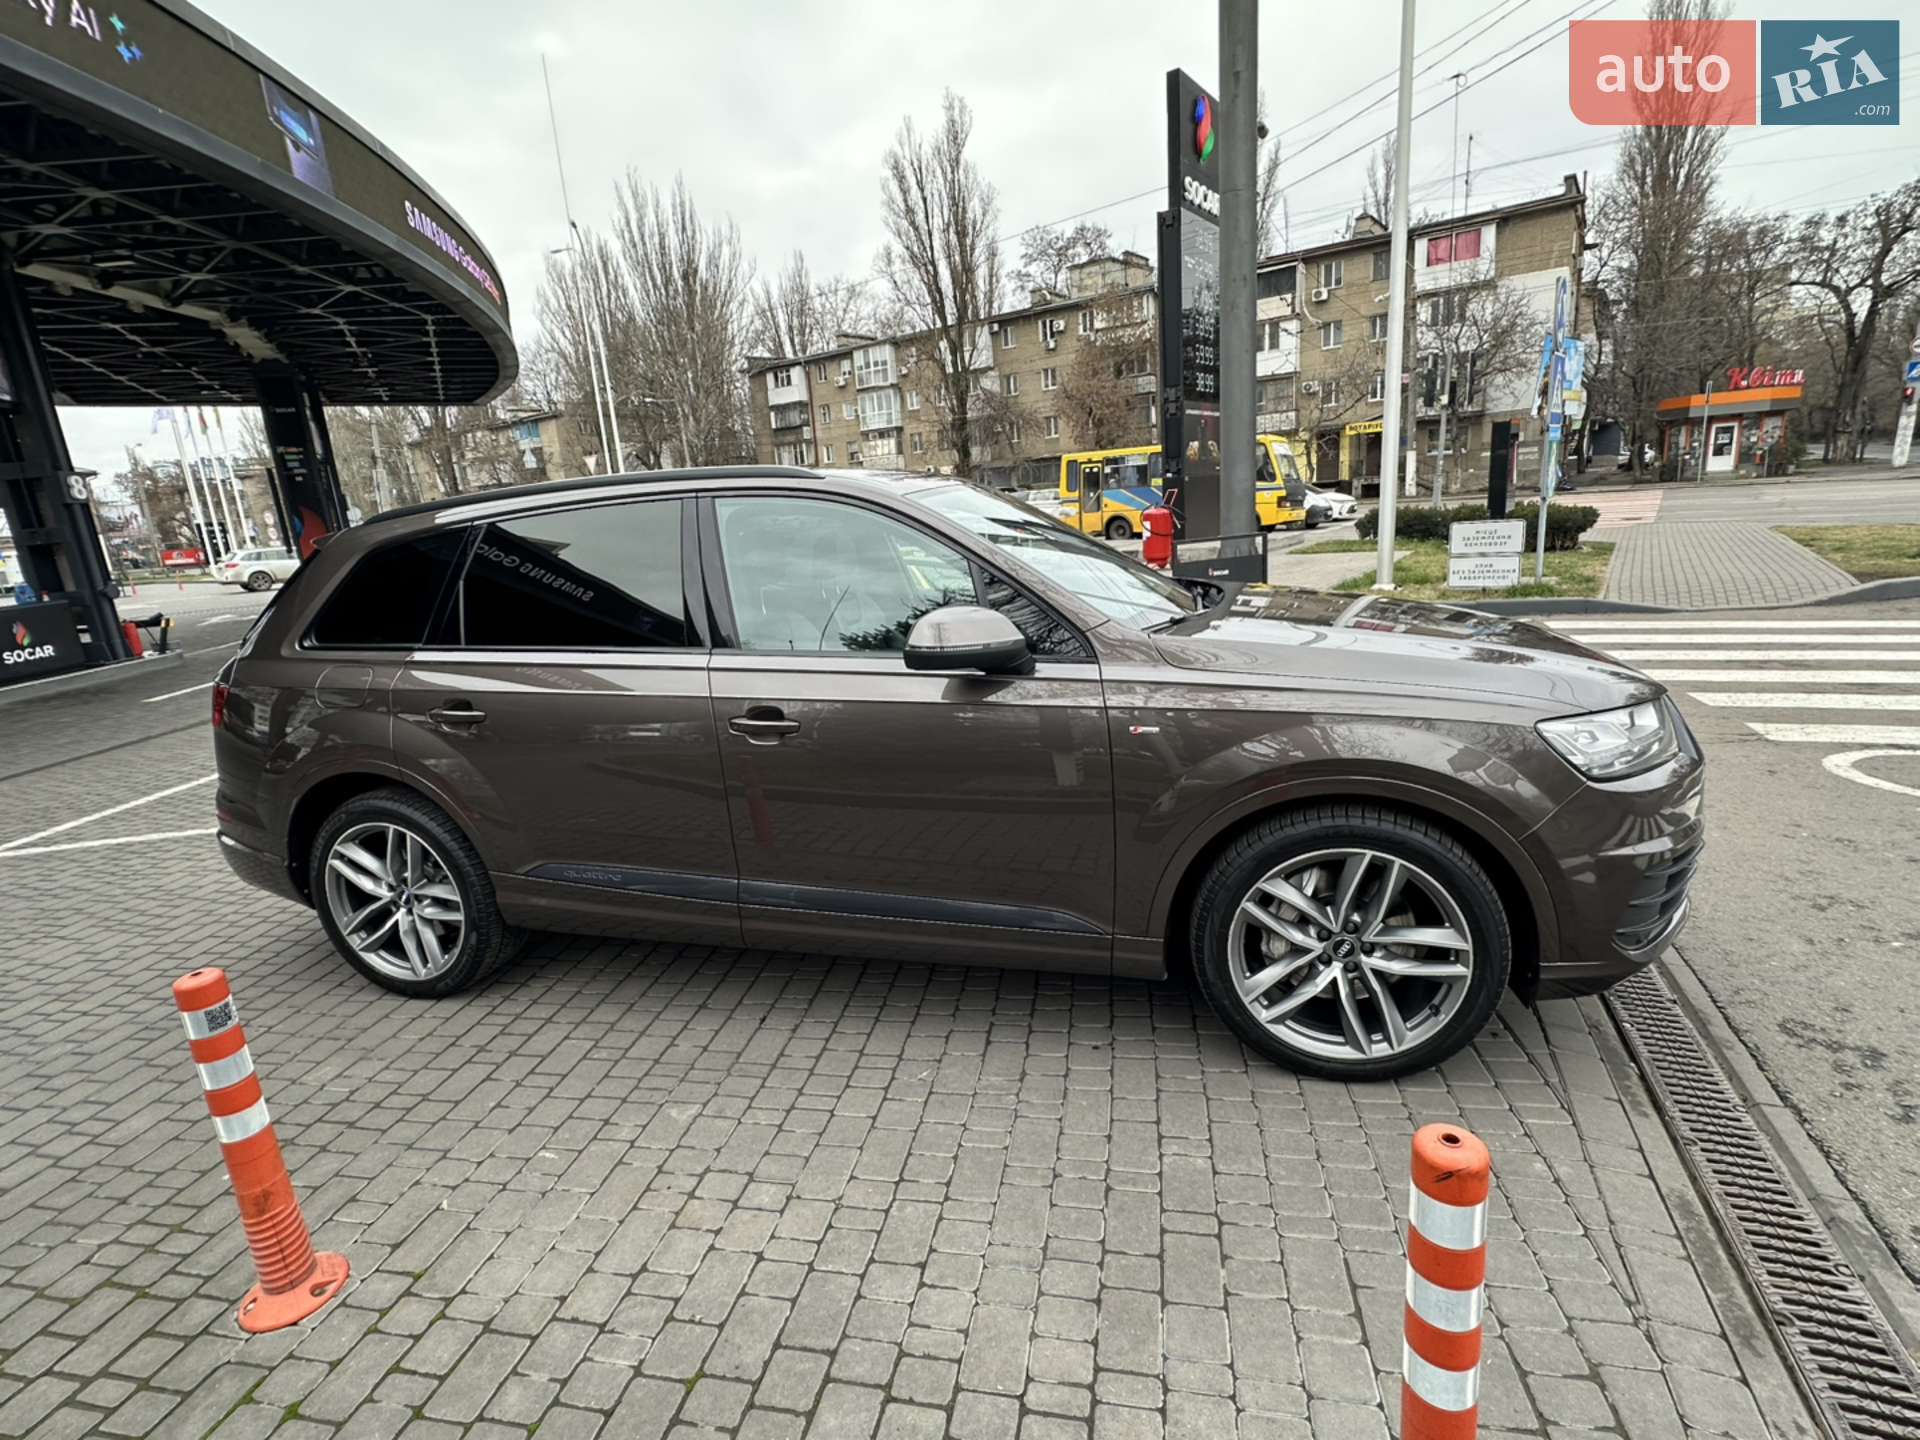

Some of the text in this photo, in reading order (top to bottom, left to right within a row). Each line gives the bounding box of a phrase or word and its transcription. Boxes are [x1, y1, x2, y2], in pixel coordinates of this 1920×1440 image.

[404, 199, 460, 262] SAMSUNG
[67, 475, 88, 500] 8
[2, 645, 56, 665] SOCAR
[562, 869, 623, 882] quattro
